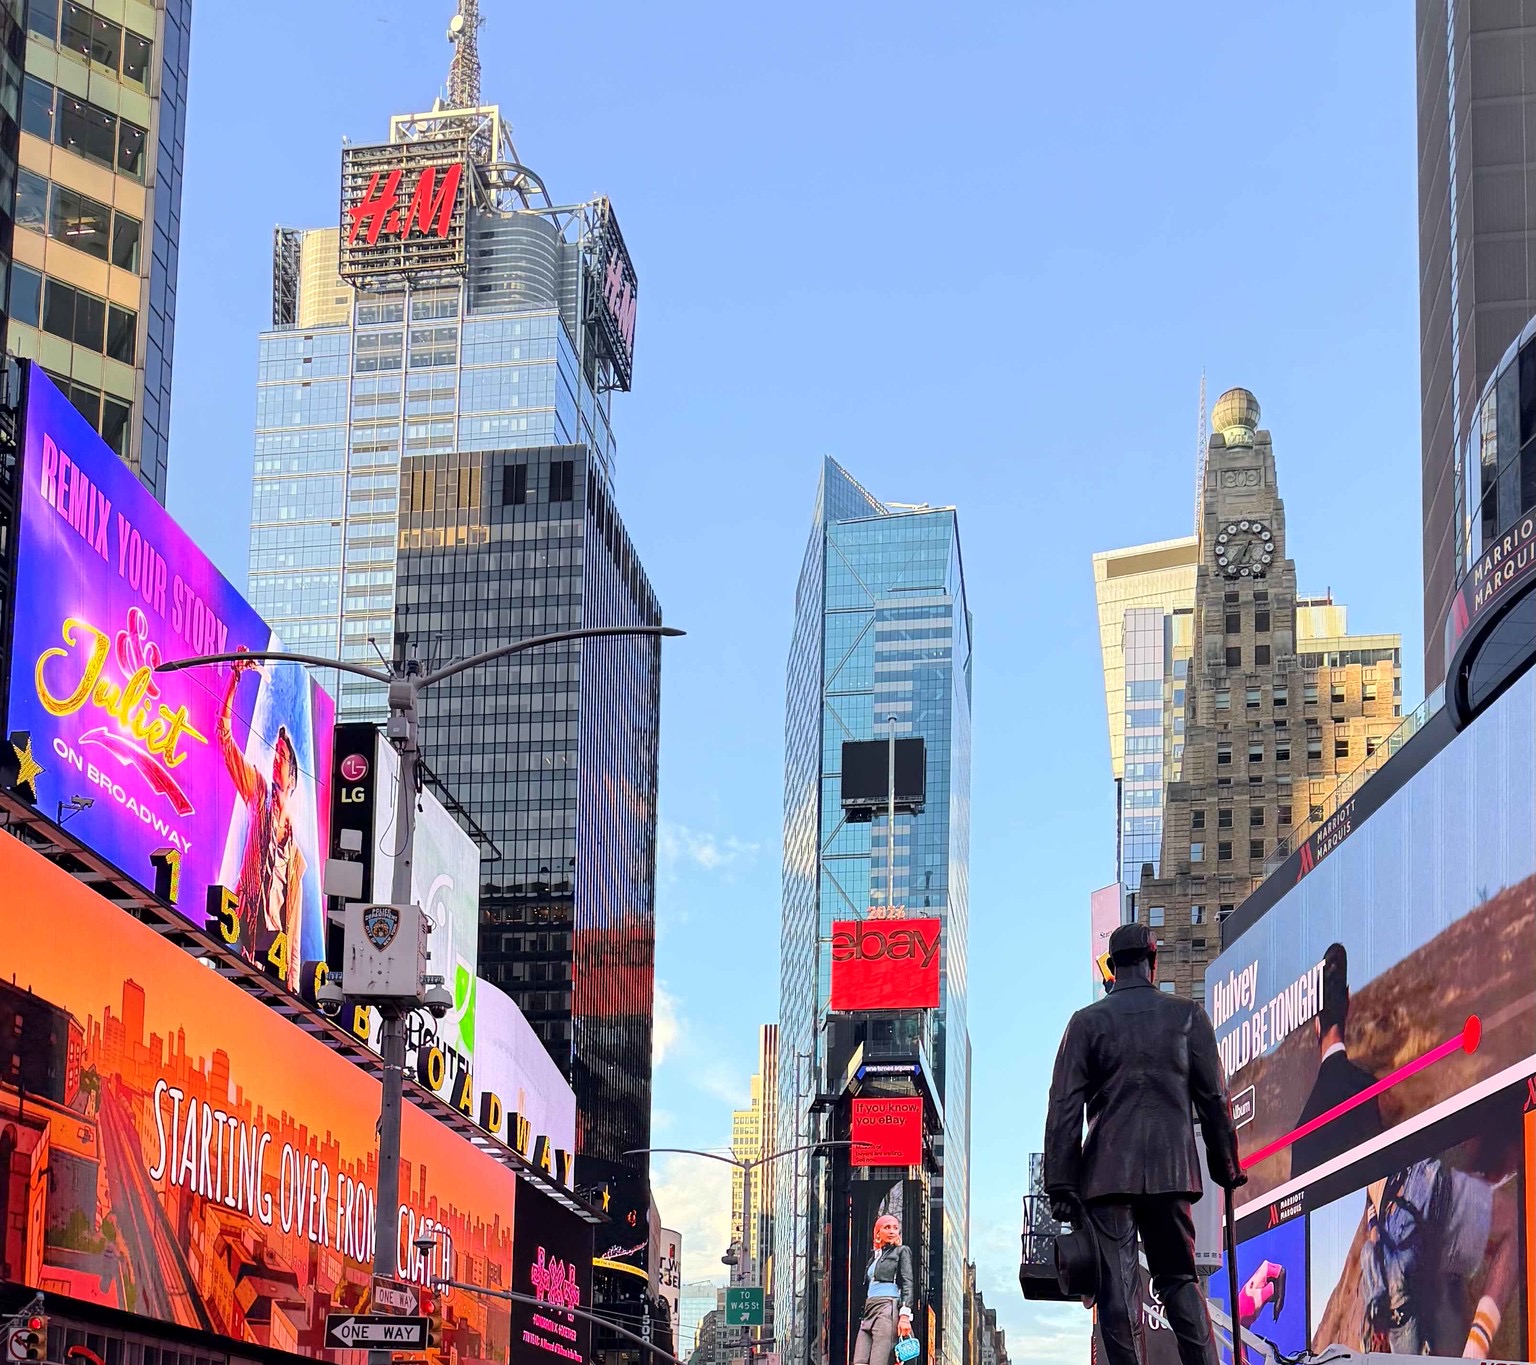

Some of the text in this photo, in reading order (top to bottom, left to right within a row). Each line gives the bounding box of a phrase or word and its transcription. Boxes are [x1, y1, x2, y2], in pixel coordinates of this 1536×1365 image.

[348, 163, 462, 246] H&M
[41, 432, 229, 676] REMIX YOUR STORY
[1474, 514, 1536, 586] MARRIO
[1475, 542, 1536, 611] MARQUI
[35, 617, 208, 768] Juliet
[53, 737, 193, 854] ON BROADWAY
[341, 787, 365, 803] LG
[1317, 799, 1356, 843] MARRIOTT
[1317, 820, 1351, 860] MARQUIS
[832, 921, 941, 968] ebay
[1213, 959, 1258, 1031] Hulvey
[1216, 959, 1326, 1079] OULD BE TONIGHT
[856, 1102, 919, 1114] If you know,
[856, 1114, 907, 1126] you eBay.
[150, 1078, 272, 1225] STARTING
[279, 1142, 329, 1247] OVER
[397, 1203, 452, 1296] CRATCH
[1280, 1191, 1305, 1210] MARRIOTT
[1280, 1203, 1302, 1220] MARQUIS
[380, 1288, 414, 1308] ONE WAY
[739, 1301, 751, 1309] 45
[751, 1301, 760, 1310] St
[740, 1291, 751, 1299] TO
[341, 1325, 414, 1340] ONE WAY
